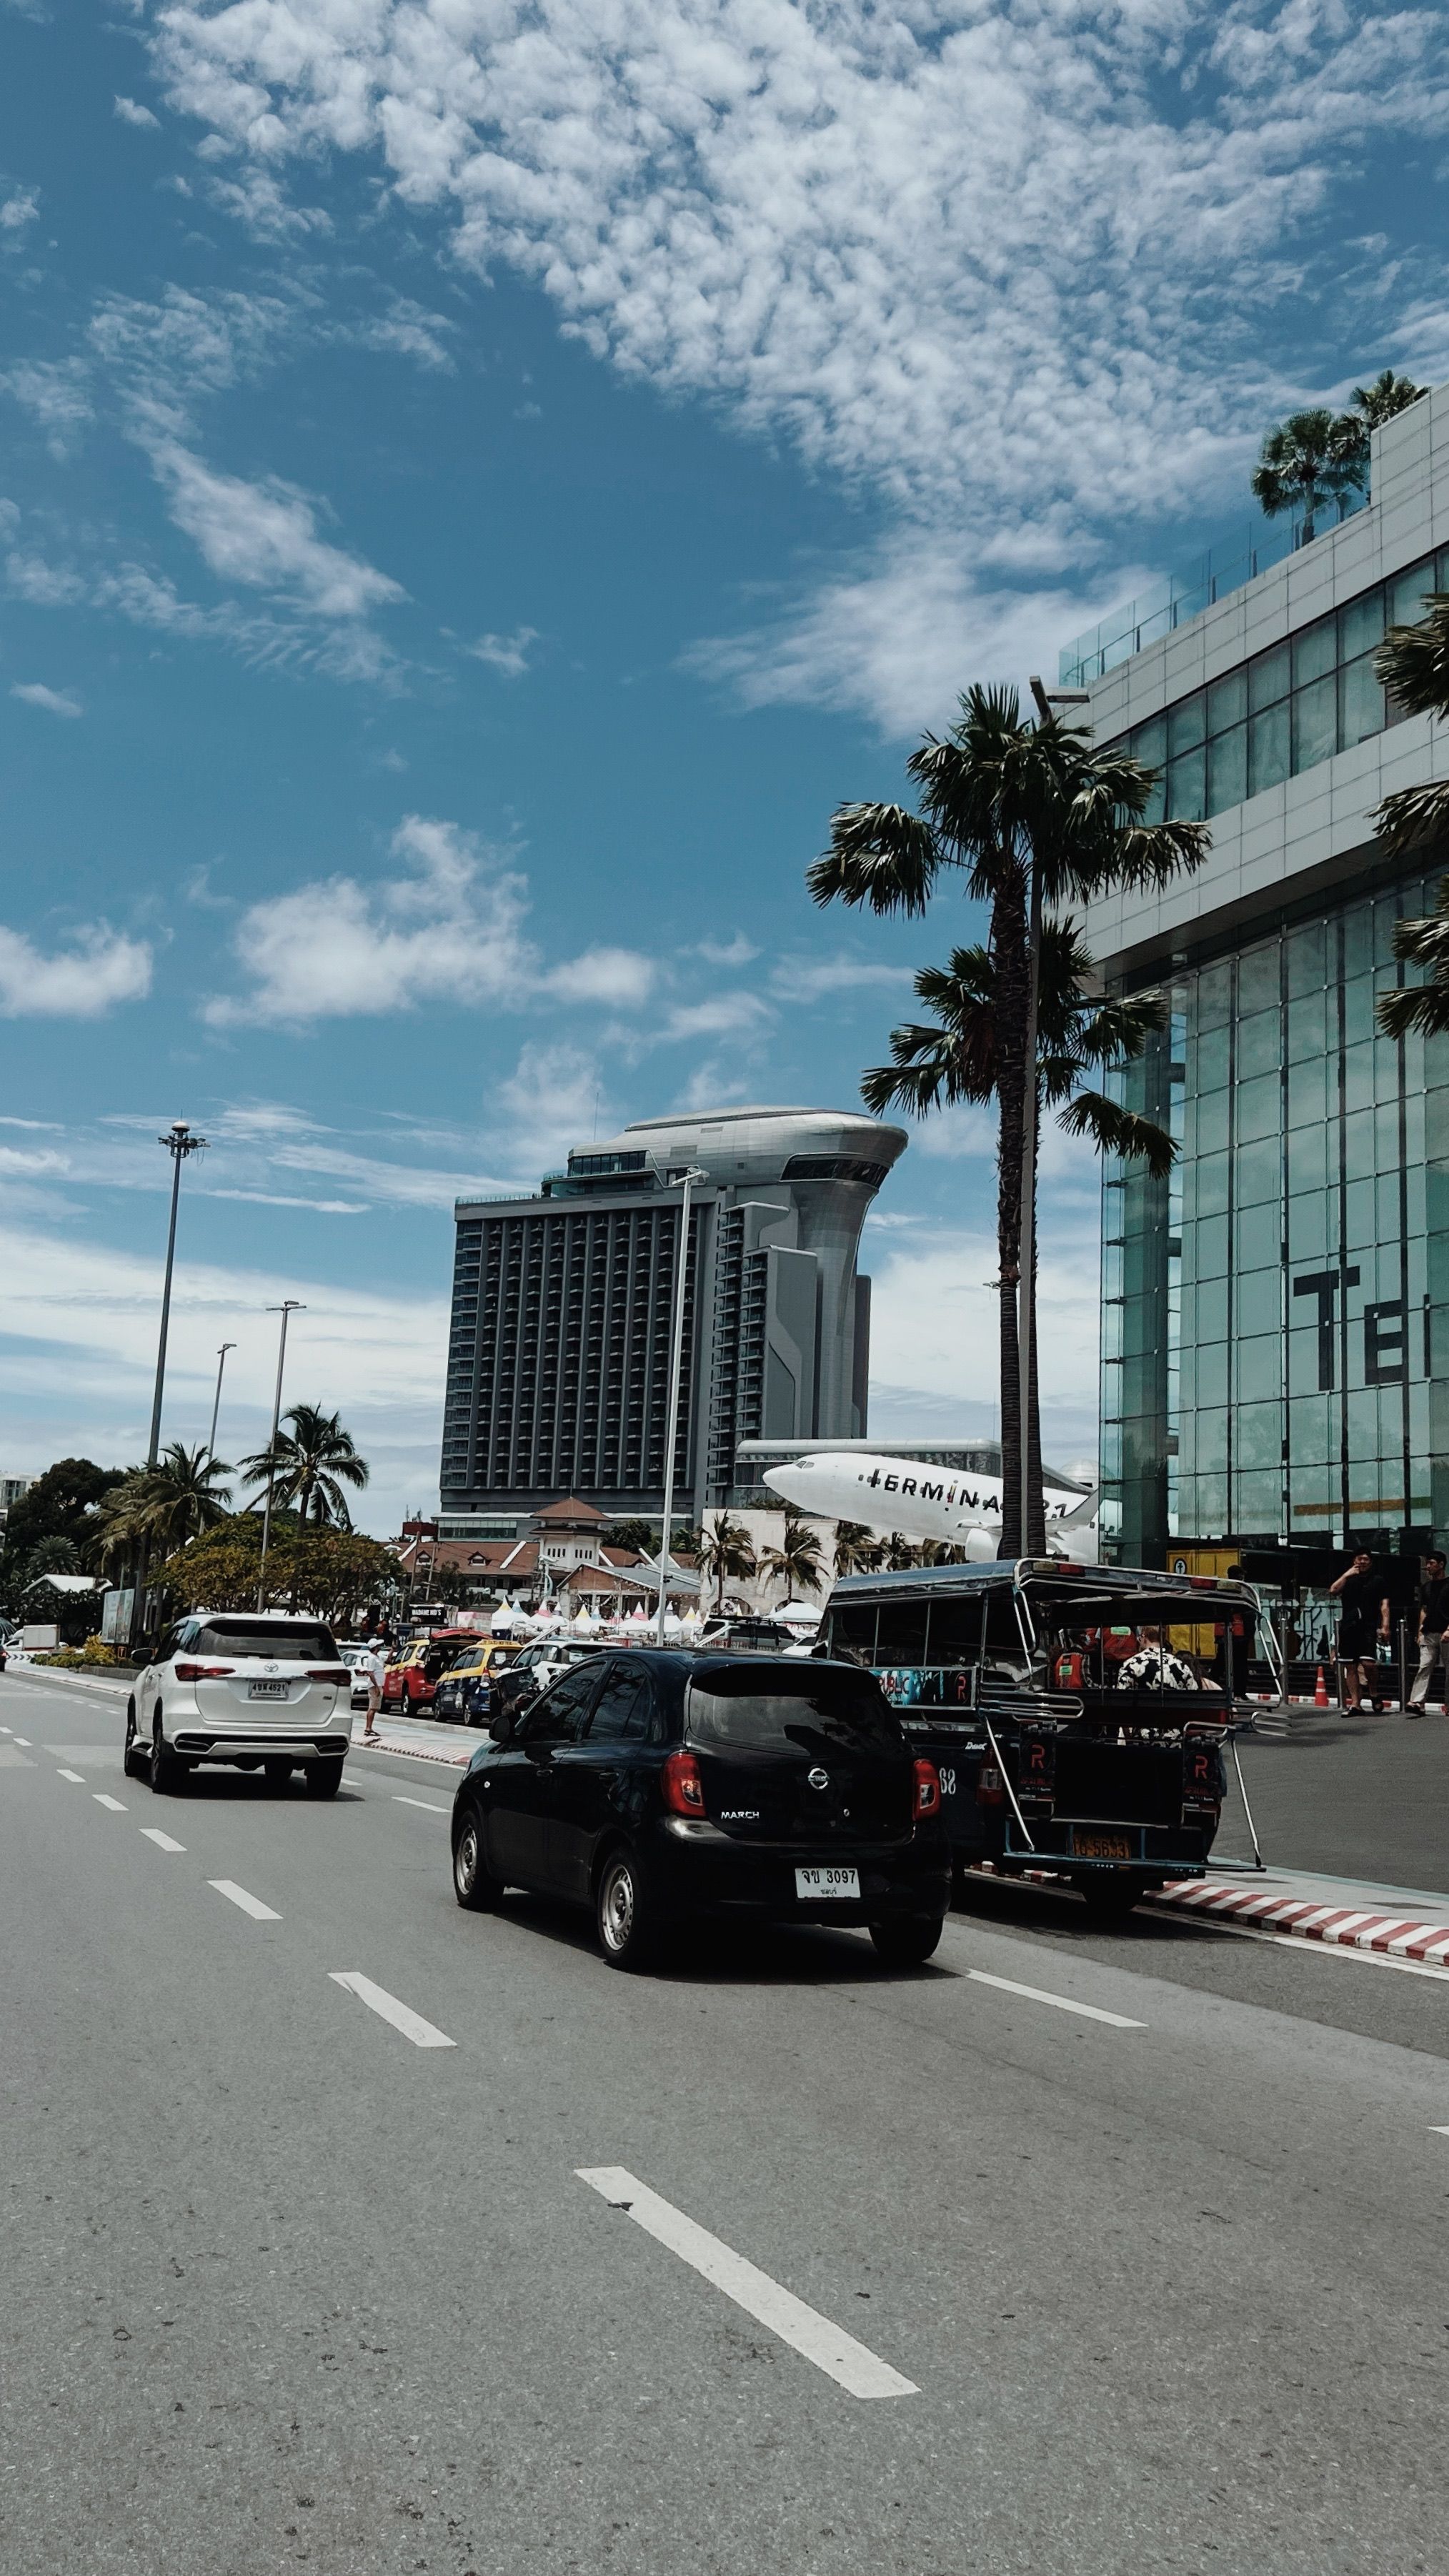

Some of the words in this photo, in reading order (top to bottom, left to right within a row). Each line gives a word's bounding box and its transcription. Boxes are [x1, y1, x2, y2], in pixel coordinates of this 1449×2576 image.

[870, 1468, 1002, 1513] TERMINA
[1031, 1744, 1045, 1769] R
[1195, 1755, 1208, 1779] R
[827, 1870, 855, 1884] 3097
